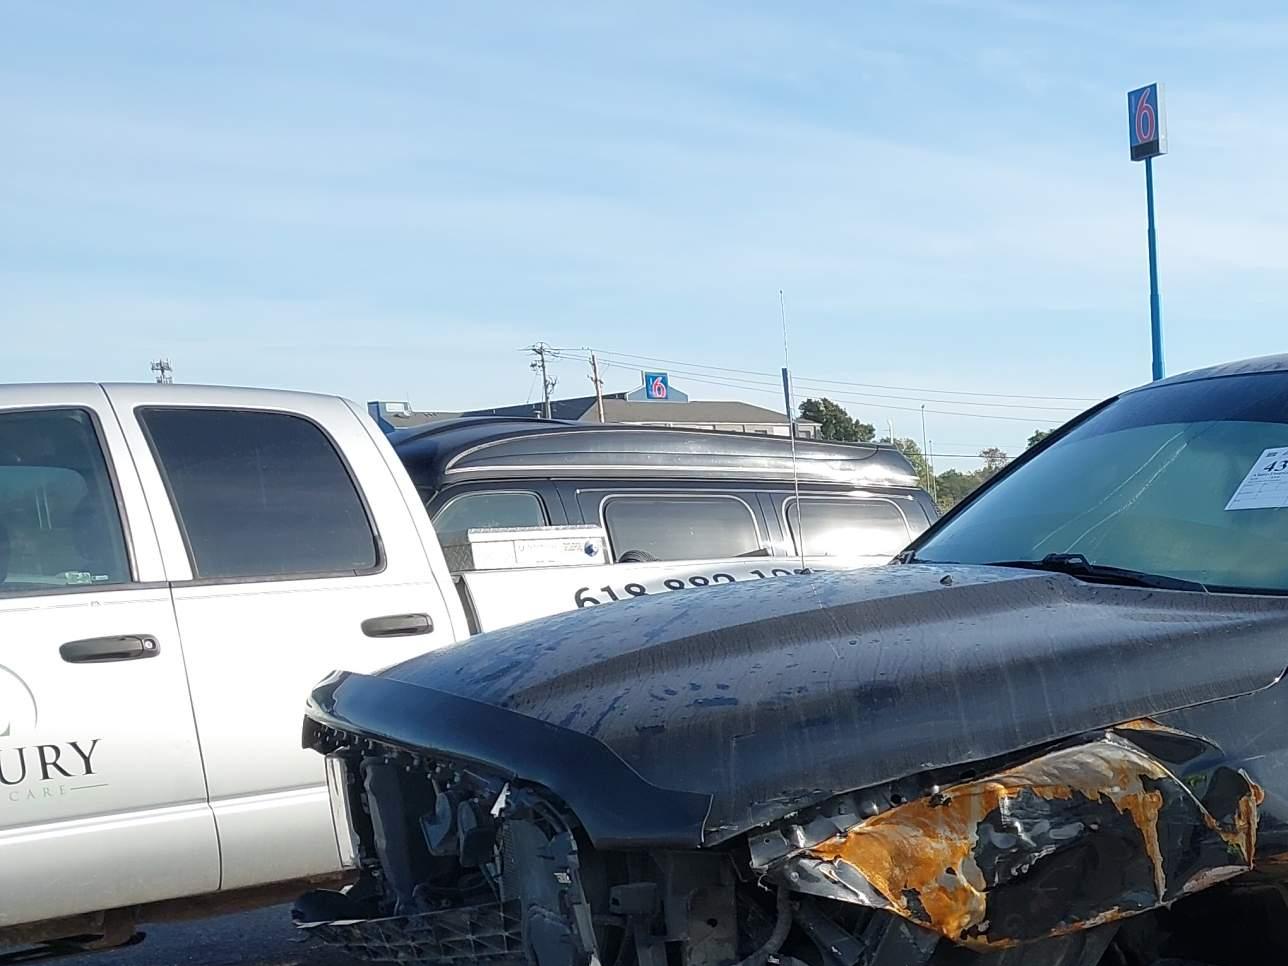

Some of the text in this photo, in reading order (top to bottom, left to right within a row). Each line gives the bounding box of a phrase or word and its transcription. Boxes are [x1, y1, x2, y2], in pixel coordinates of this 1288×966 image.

[1136, 88, 1156, 144] 6
[652, 376, 667, 398] 6
[8, 784, 67, 802] CARE
